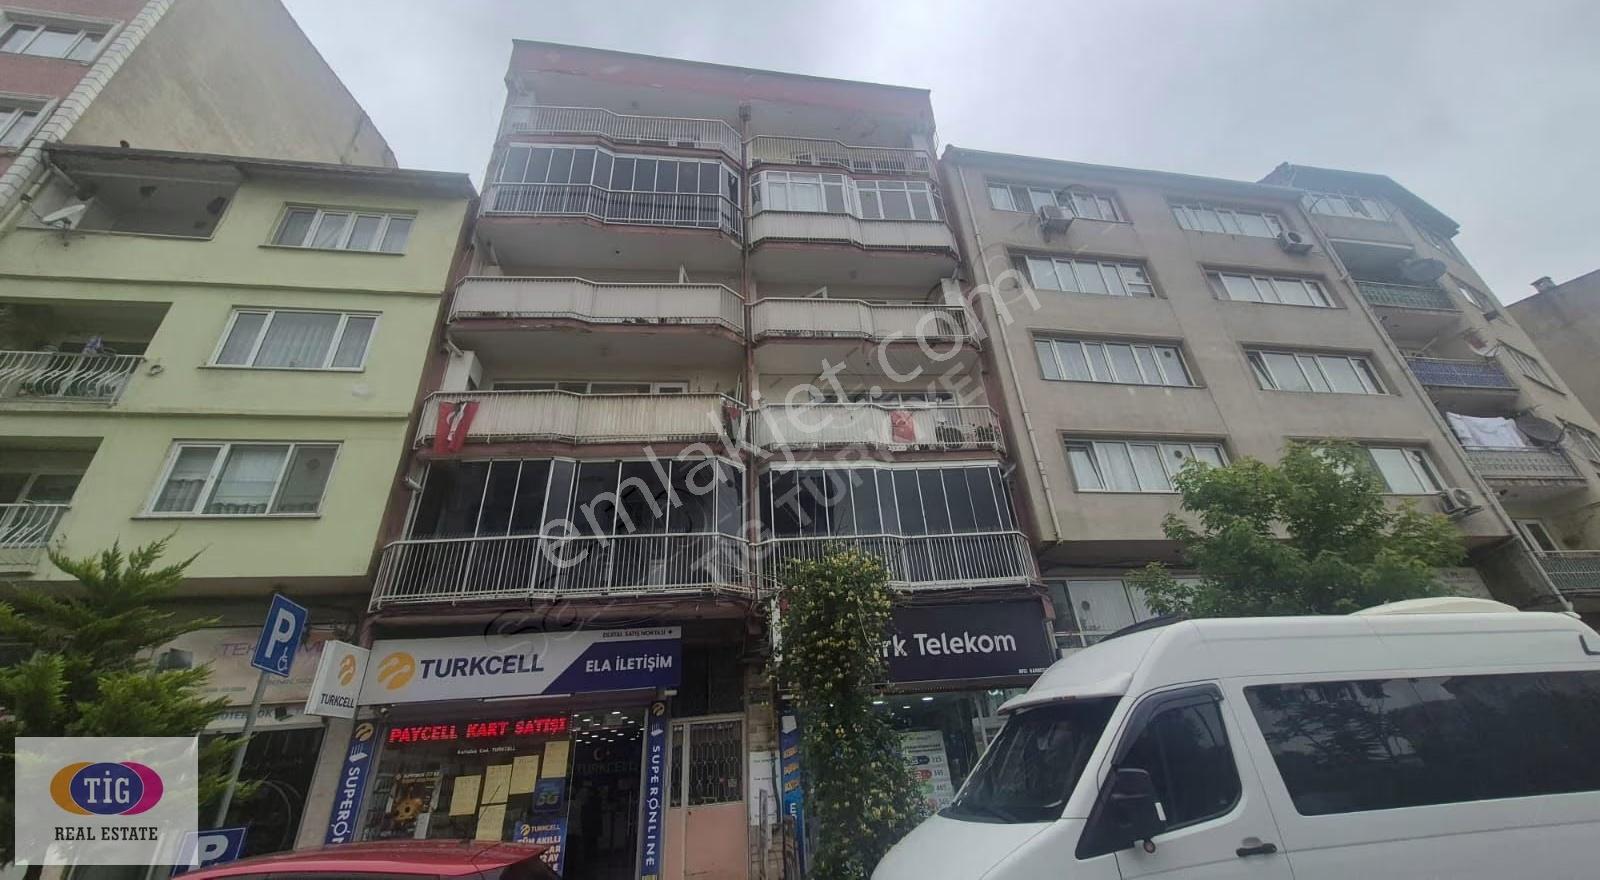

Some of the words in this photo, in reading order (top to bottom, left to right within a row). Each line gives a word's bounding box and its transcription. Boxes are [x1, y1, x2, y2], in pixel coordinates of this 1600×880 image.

[265, 607, 296, 658] P
[913, 631, 1016, 656] Telekom
[421, 654, 544, 679] TURKCELL
[586, 658, 612, 673] ELA
[615, 652, 673, 672] İLETİŞİM
[321, 693, 355, 708] TURKCELL
[389, 724, 458, 744] PAYCELL
[466, 720, 509, 739] KART
[646, 745, 660, 867] SUPERONLINE
[188, 835, 228, 872] P
